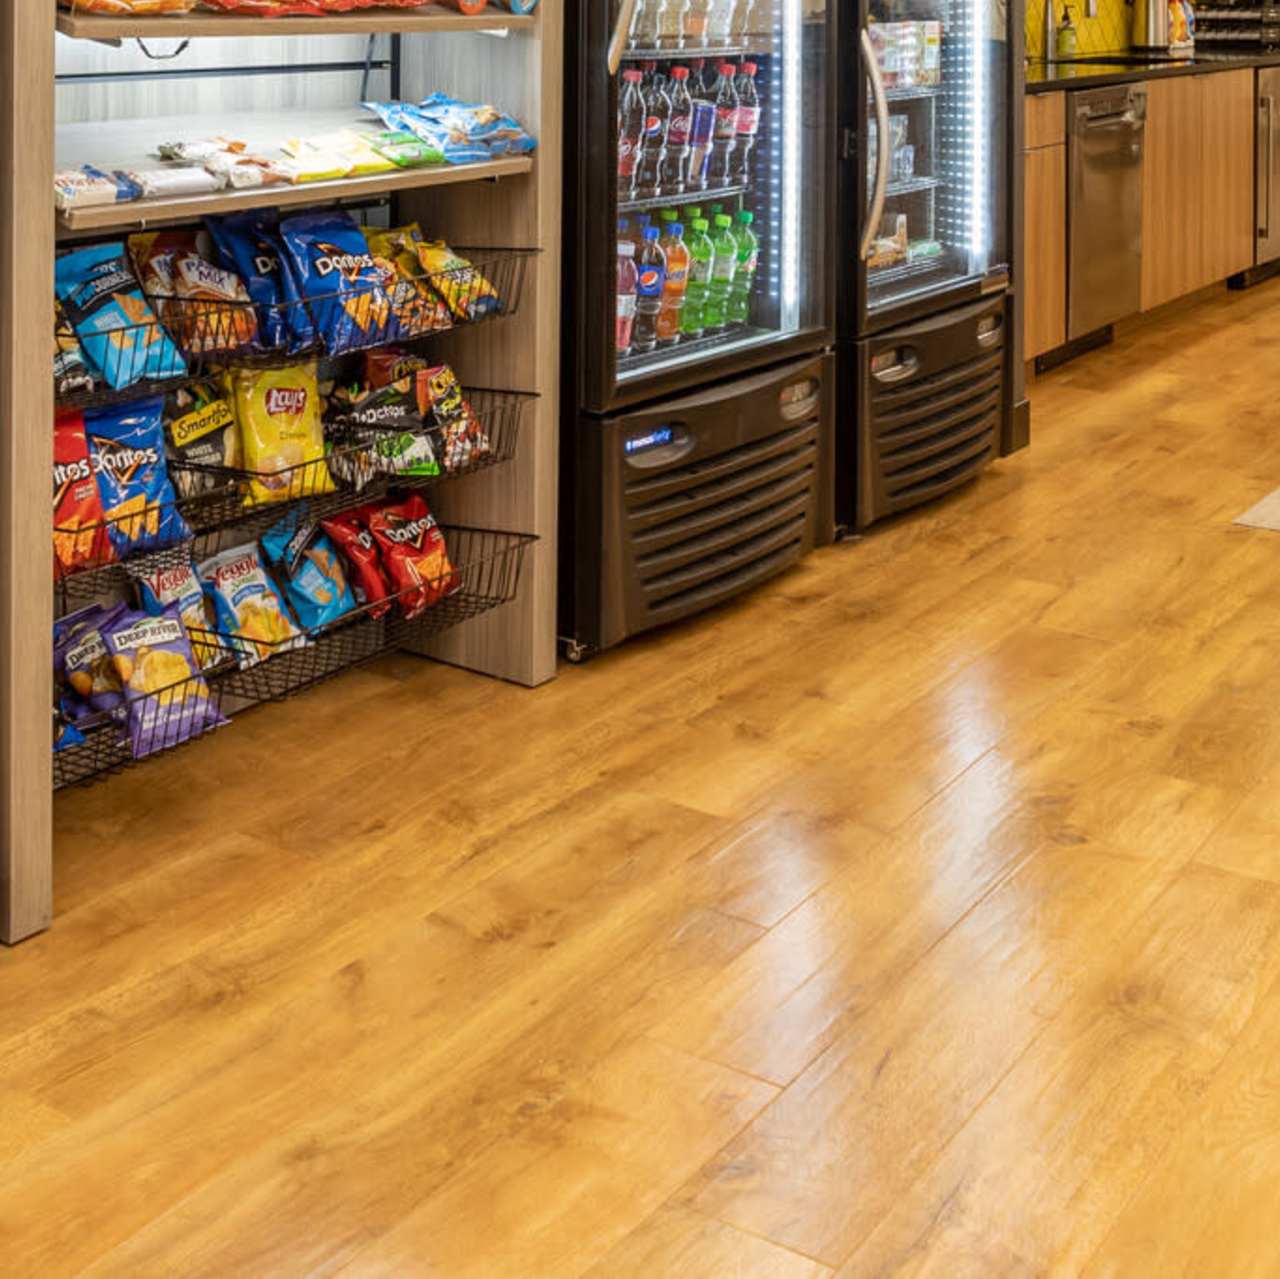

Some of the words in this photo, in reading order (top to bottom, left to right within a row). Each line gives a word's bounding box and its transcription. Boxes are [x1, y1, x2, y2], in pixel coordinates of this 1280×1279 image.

[314, 253, 374, 277] Doritos
[90, 446, 159, 473] Doritos
[117, 629, 149, 646] DEEP
